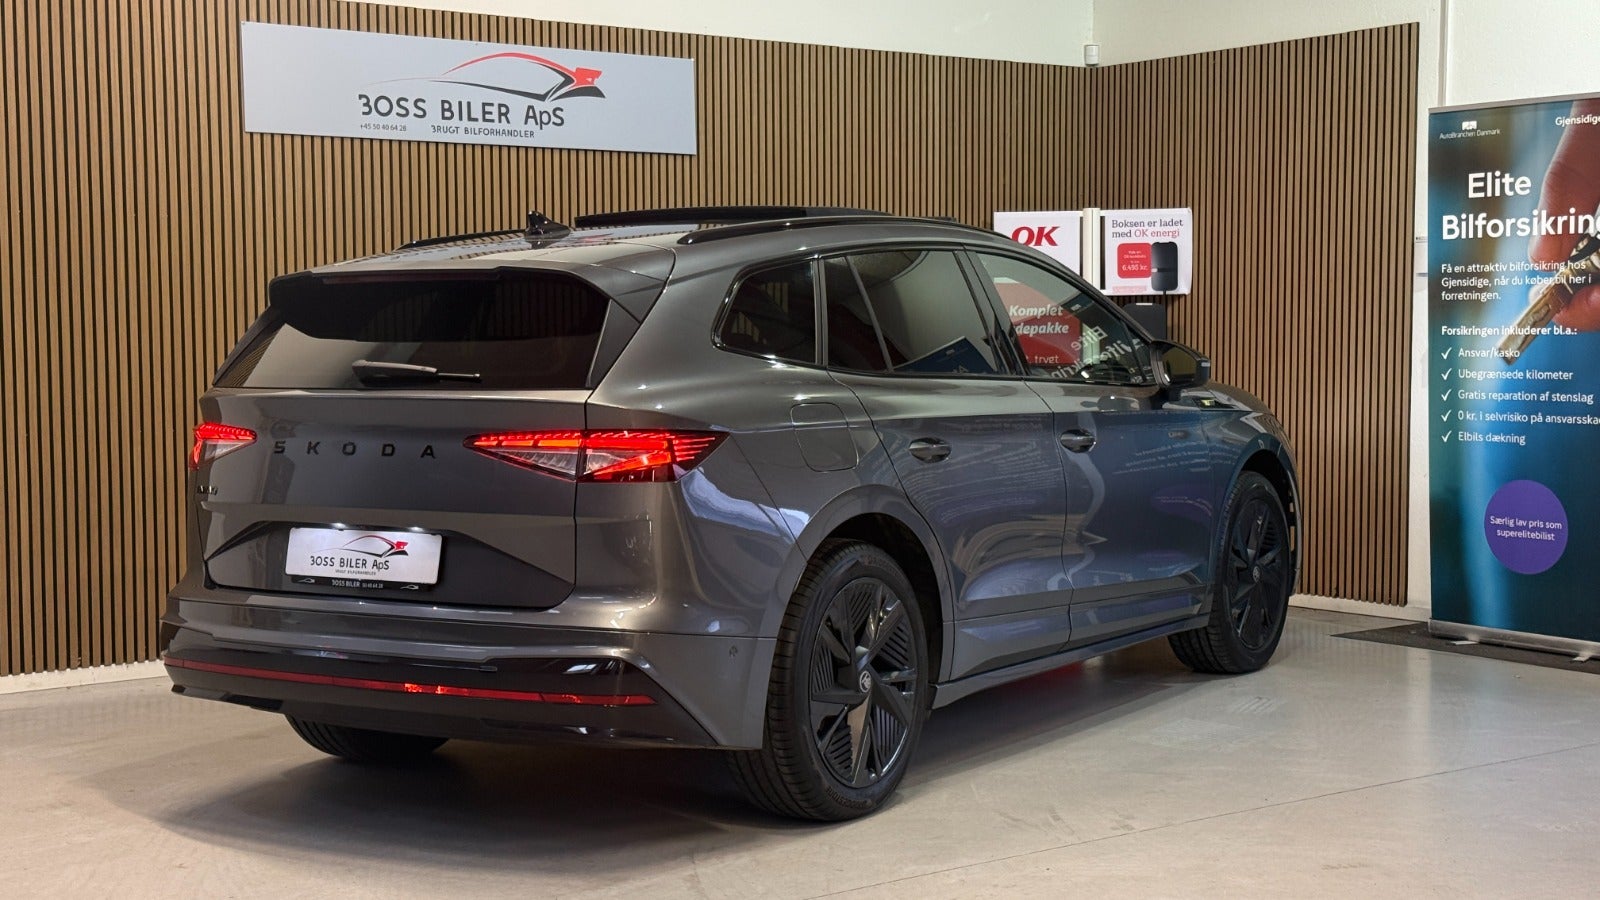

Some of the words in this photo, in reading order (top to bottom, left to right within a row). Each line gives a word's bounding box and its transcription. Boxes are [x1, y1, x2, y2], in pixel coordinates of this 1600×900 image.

[440, 99, 511, 124] BILER
[523, 104, 565, 131] ApS
[464, 126, 535, 138] BILFORHANDLER
[1476, 128, 1501, 137] Danmark
[1468, 170, 1532, 199] Elite
[1111, 219, 1145, 229] Boksen
[1147, 220, 1157, 228] er
[1159, 218, 1184, 227] ladet
[1442, 207, 1600, 240] Bilforsikrin
[1011, 226, 1060, 247] OK
[1111, 229, 1132, 238] med
[1134, 228, 1148, 238] OK
[1150, 228, 1180, 239] energi
[1441, 263, 1452, 274] Få
[1454, 265, 1465, 274] en
[1467, 262, 1508, 273] attraktiv
[1509, 260, 1566, 273] bilforsikring
[1567, 259, 1586, 270] hos
[1441, 276, 1492, 289] Gjensidige,
[1494, 275, 1509, 286] når
[1511, 275, 1523, 286] du
[1525, 275, 1552, 286] køber
[1554, 274, 1567, 285] bil
[1568, 274, 1586, 284] her
[1588, 273, 1592, 284] i
[1441, 290, 1502, 302] forretningen.
[1009, 304, 1064, 319] Komplet
[1441, 325, 1500, 337] Forsikringen
[1501, 325, 1551, 336] inkluderer
[1553, 325, 1578, 336] bl.a.:
[1458, 346, 1521, 358] Ansvar/kasko
[1458, 368, 1524, 381] Ubegrænsede
[1525, 369, 1574, 381] kilometer
[1457, 389, 1486, 400] Gratis
[1488, 389, 1538, 402] reparation
[1539, 391, 1550, 402] af
[1551, 392, 1594, 405] stenslag
[1457, 410, 1464, 421] 0
[1466, 410, 1478, 421] kr.
[1484, 411, 1529, 423] selvrisiko
[1530, 412, 1543, 425] på
[1458, 431, 1484, 442] Elbils
[1485, 431, 1526, 446] dækning
[1489, 515, 1515, 528] Særlig
[1515, 517, 1528, 527] lav
[1528, 519, 1544, 529] pris
[1545, 521, 1563, 530] som
[1496, 529, 1556, 541] superelitebilist
[339, 557, 367, 569] BILER
[371, 560, 390, 572] ApS
